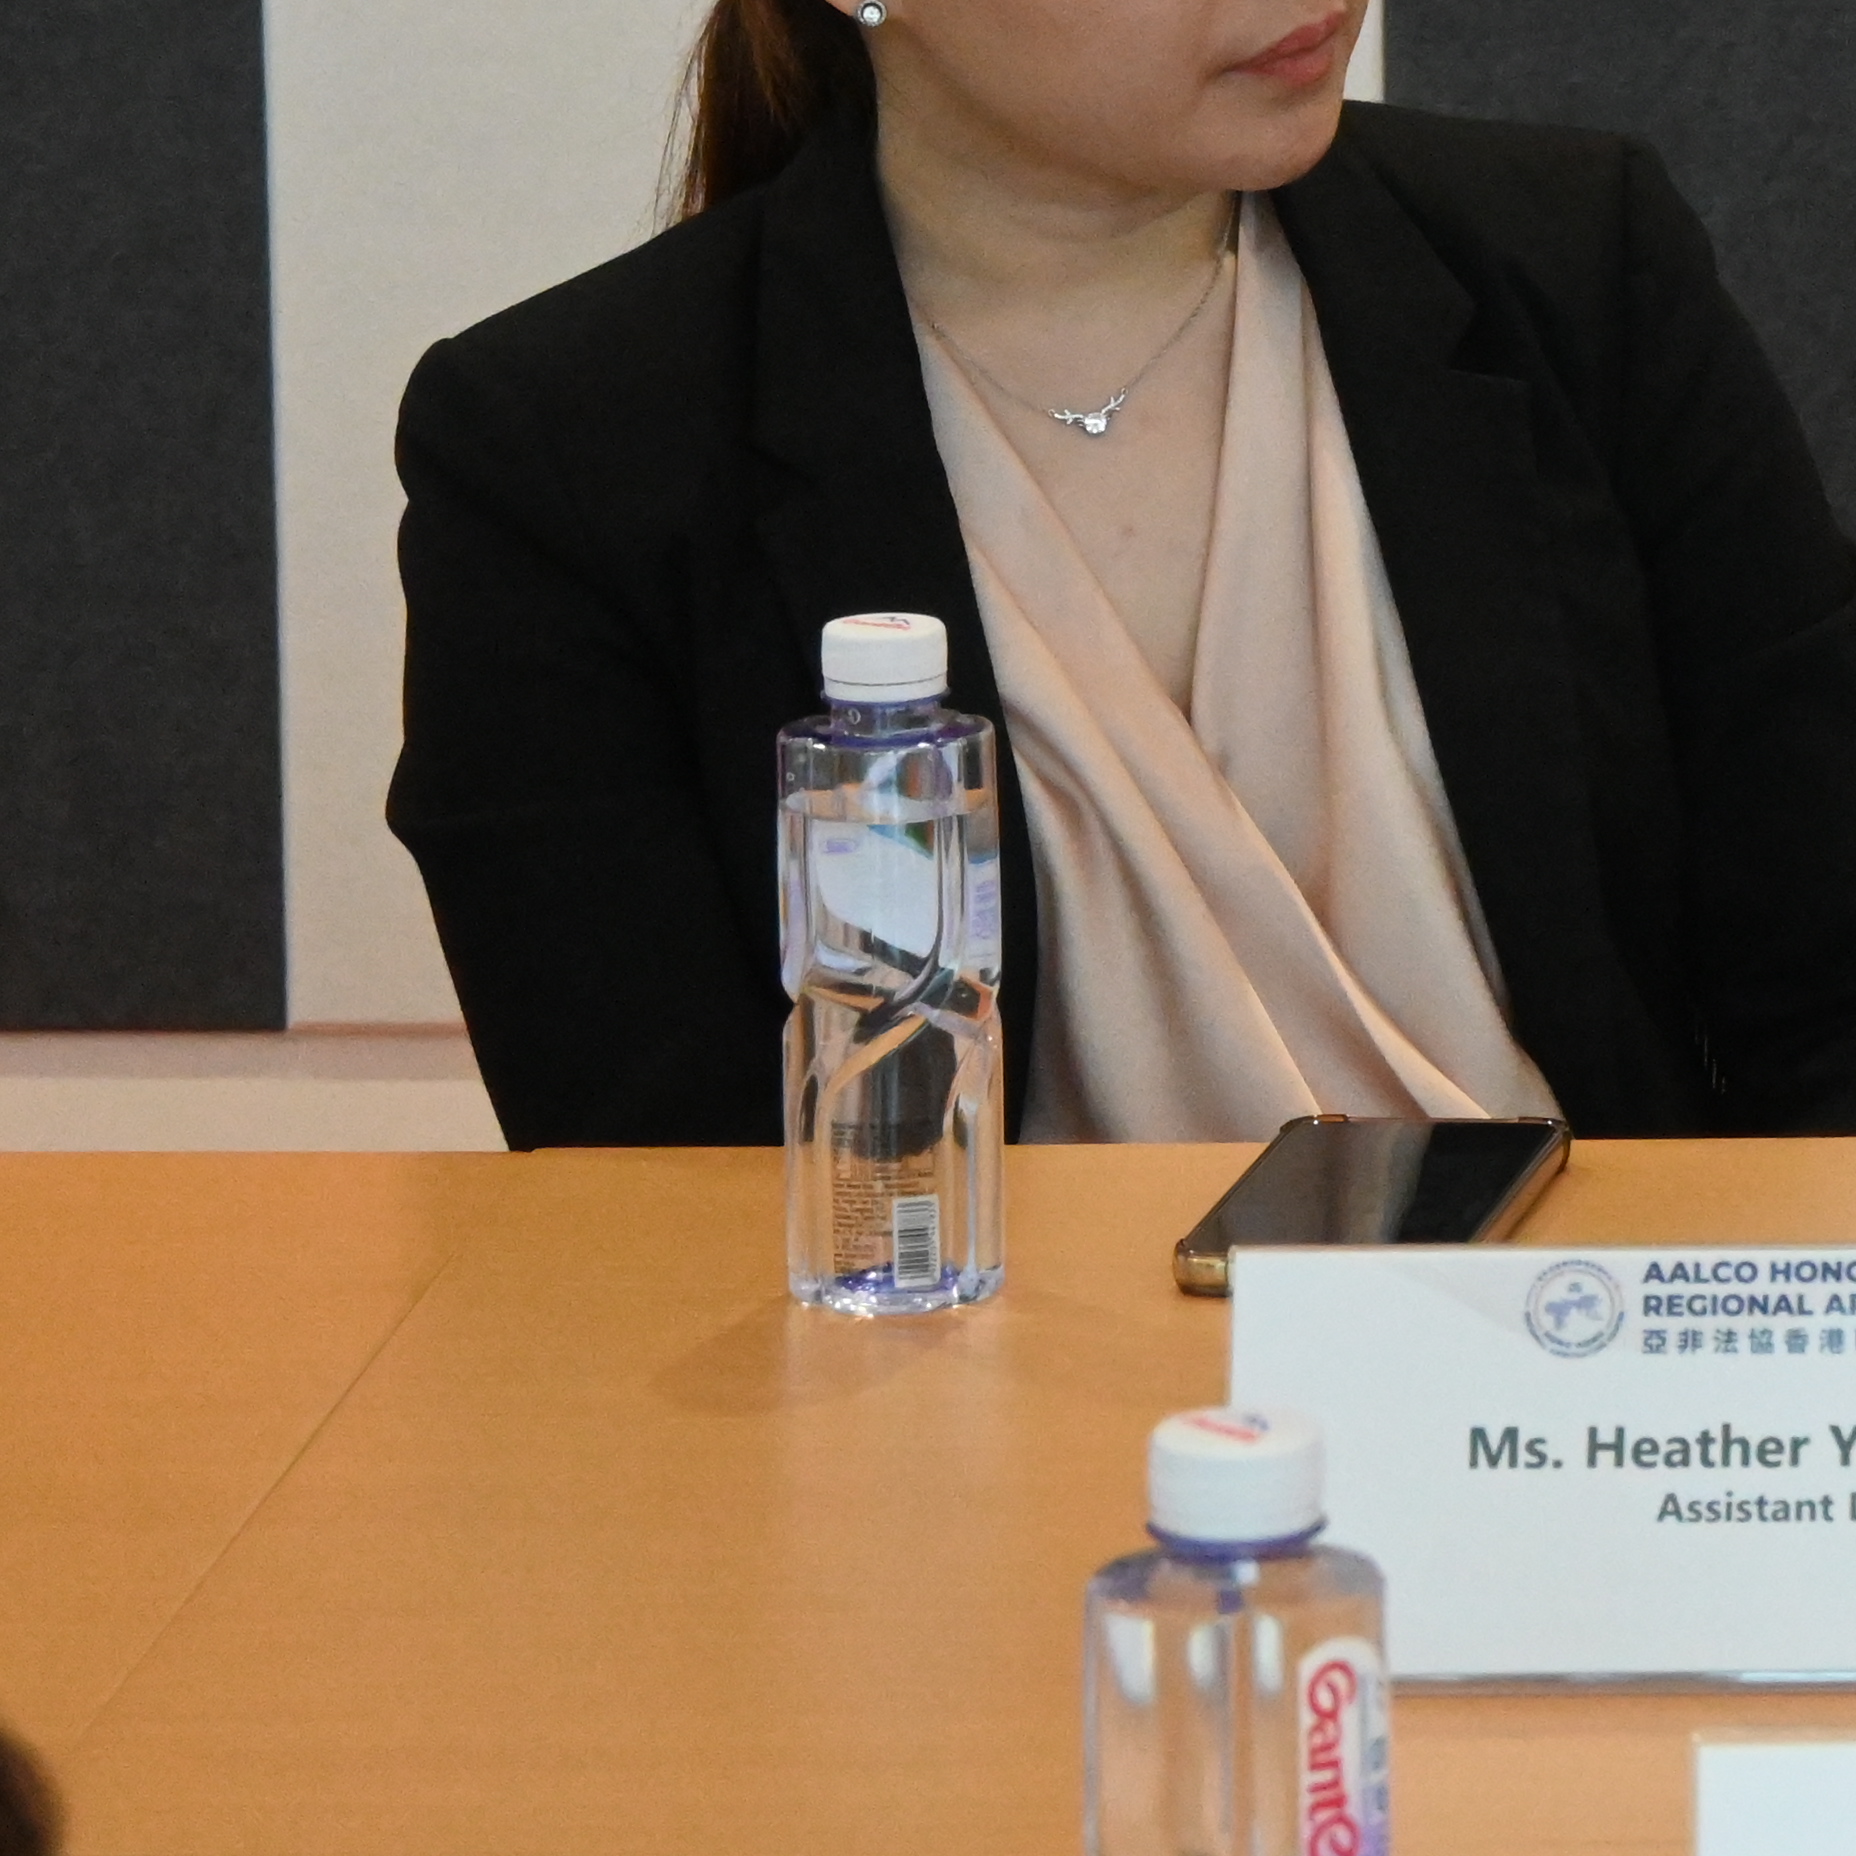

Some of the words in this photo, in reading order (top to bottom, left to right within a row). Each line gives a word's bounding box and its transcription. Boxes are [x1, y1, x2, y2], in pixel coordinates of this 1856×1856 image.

[1641, 1259, 1759, 1285] AALCO
[1643, 1293, 1814, 1318] REGIONAL
[1469, 1425, 1563, 1471] Ms.
[1586, 1422, 1811, 1470] Heather
[1657, 1490, 1834, 1524] Assistant
